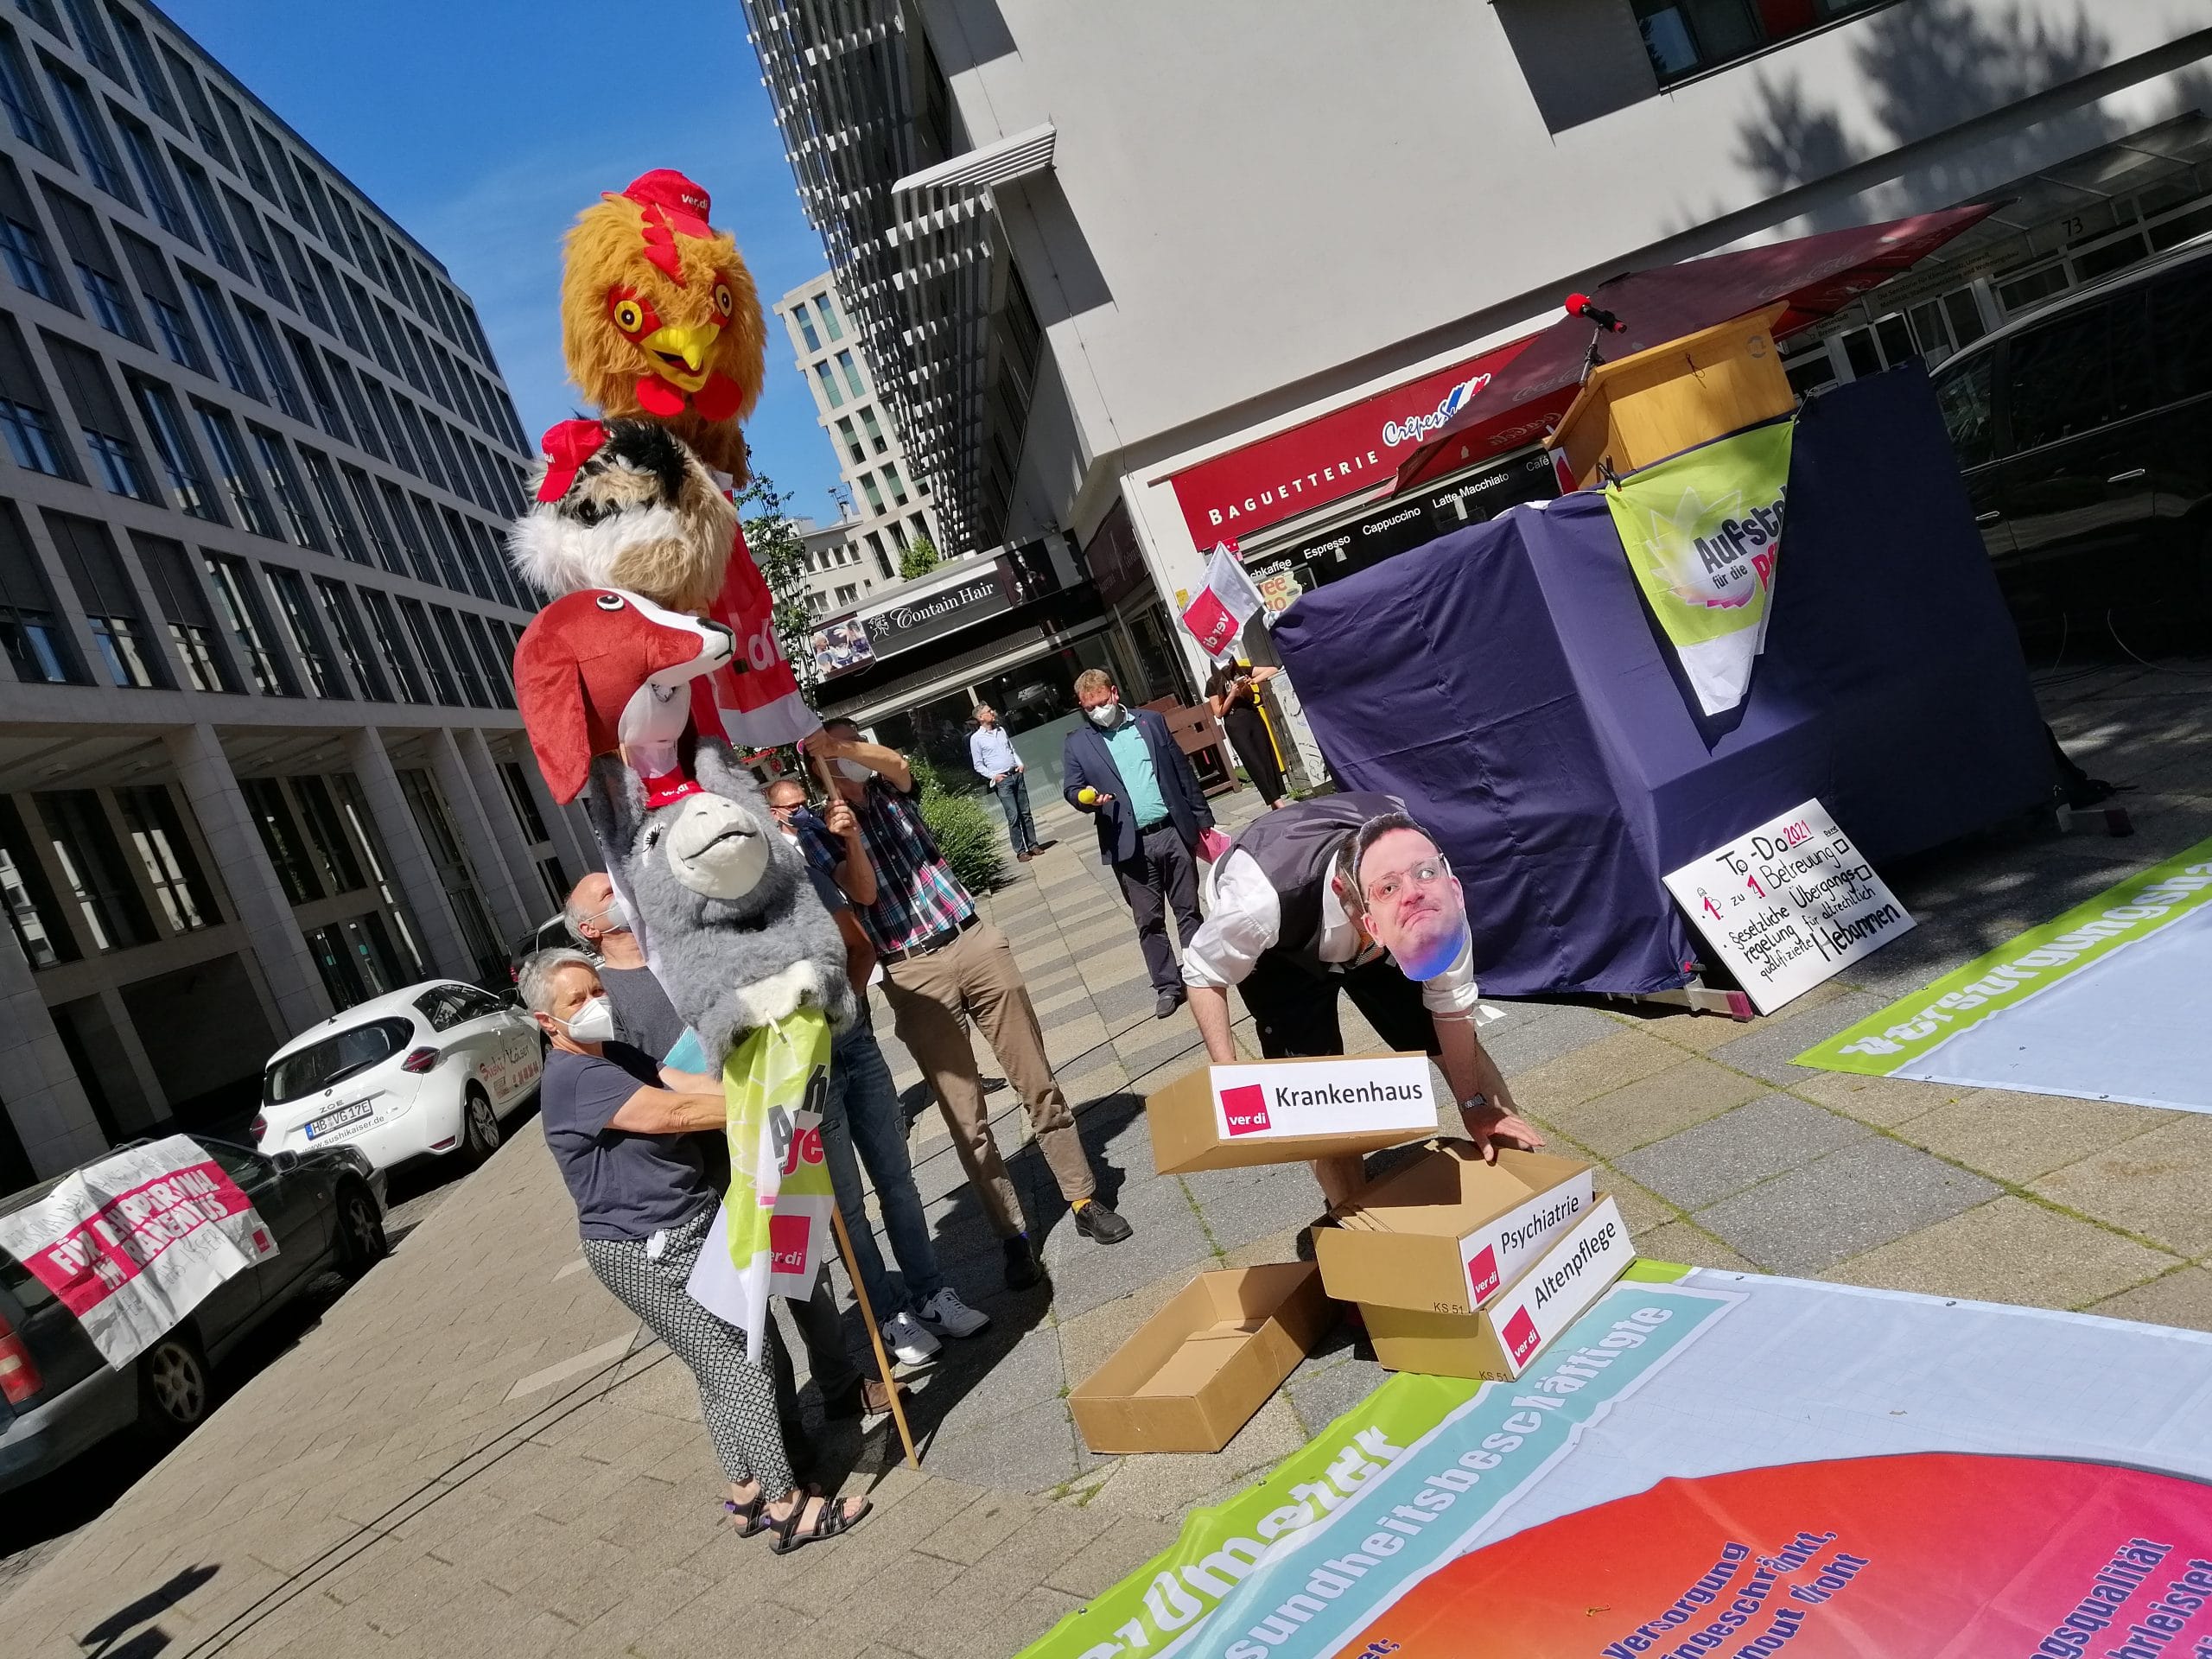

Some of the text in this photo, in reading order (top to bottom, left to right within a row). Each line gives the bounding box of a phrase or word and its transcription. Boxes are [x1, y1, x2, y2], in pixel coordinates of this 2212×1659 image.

[2062, 216, 2083, 237] 73
[1208, 450, 1379, 527] BAGUETTERIE
[1303, 535, 1351, 560] Espresso
[1362, 506, 1421, 536] Cappuccino
[1433, 493, 1459, 509] Latte
[1459, 472, 1510, 499] Macchiato
[1526, 455, 1550, 472] Café
[1712, 564, 1748, 589] für die
[889, 581, 995, 629] Contain Hair
[1783, 819, 1812, 845] 2021
[1730, 893, 1745, 906] zu
[1759, 847, 1841, 890] Betreuung
[1744, 925, 1802, 964] regelung
[1802, 915, 1820, 932] für
[1760, 904, 1901, 982] qualifizierte Hebammen
[312, 1102, 370, 1134] HB VG 17E
[319, 1099, 344, 1113] ZOE
[1275, 1081, 1423, 1108] Krankenhaus
[1500, 1194, 1580, 1255] Psychiatrie
[48, 1229, 103, 1276] FÜR
[1535, 1220, 1616, 1310] Altenpflege
[1433, 1301, 1465, 1314] KS 51
[1478, 1370, 1509, 1382] KS 51
[1600, 1541, 1751, 1659] Versorgung
[1789, 1552, 1871, 1605] droht
